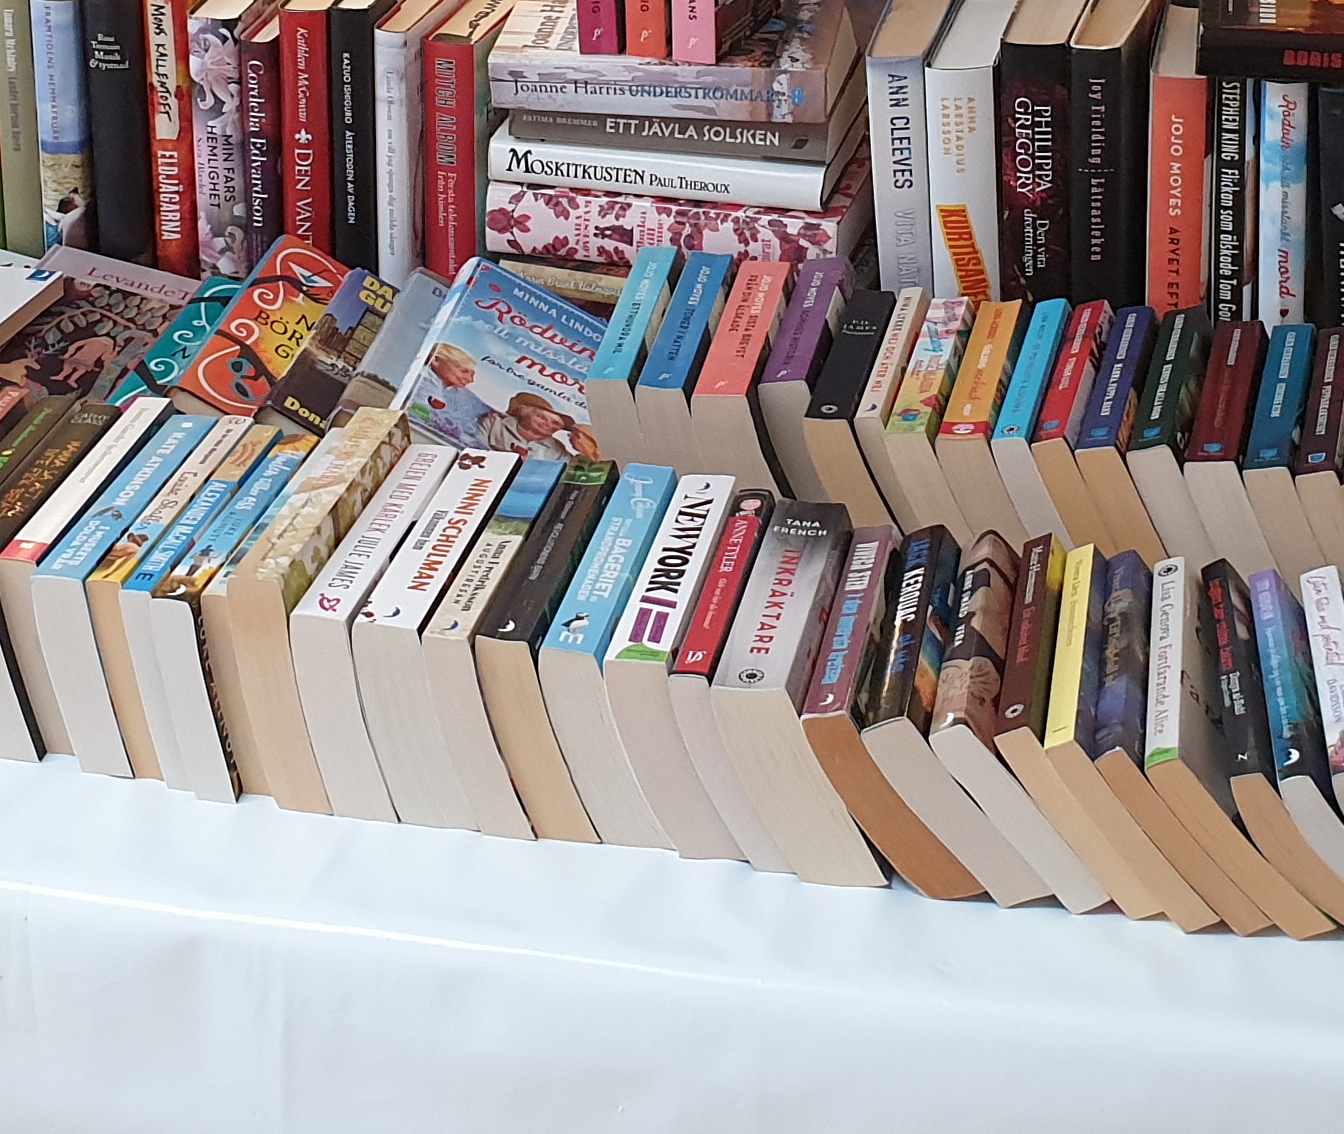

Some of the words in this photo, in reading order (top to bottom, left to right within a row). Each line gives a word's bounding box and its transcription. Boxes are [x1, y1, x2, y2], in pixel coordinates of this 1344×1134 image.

[44, 5, 55, 70] FRAMTIDENS
[296, 26, 309, 71] Kathleen
[154, 43, 173, 123] KALLENTOFT
[342, 53, 351, 83] KAZUO
[435, 58, 456, 108] MITCH
[514, 79, 567, 95] Joanne
[574, 80, 626, 96] Harris
[247, 60, 266, 132] Cordelia
[343, 84, 353, 124] ISHIGURO
[887, 73, 909, 109] ANN
[1221, 81, 1240, 129] STEPHEN
[221, 134, 235, 162] MIN
[435, 113, 457, 166] ALBOM
[605, 118, 638, 135] ETT
[641, 119, 698, 140] JÄVLA
[703, 125, 780, 147] SOLSKEN
[889, 115, 914, 190] CLEEVES
[1014, 96, 1033, 200] GREGORY
[1033, 105, 1053, 194] PHILIPPA
[1088, 102, 1107, 165] Fielding
[1171, 114, 1184, 156] JOJO
[1220, 132, 1239, 162] KING
[206, 125, 221, 210] HEMLIGHET
[294, 149, 313, 191] DEN
[345, 131, 356, 183] ÅTERSTODEN
[506, 147, 646, 186] MOSKITKUSTEN
[648, 173, 676, 190] PAUL
[677, 176, 731, 195] THEROUX
[157, 150, 182, 241] ELDJÄGARNA
[223, 167, 236, 203] FARS
[250, 138, 269, 227] Edvardson
[1169, 161, 1183, 217] MOYES
[1220, 168, 1240, 203] Flickan
[347, 196, 356, 224] DAGEN
[1037, 219, 1050, 240] Den
[1220, 205, 1235, 230] som
[1023, 208, 1036, 277] drottningen
[1037, 242, 1049, 269] vita
[1168, 226, 1182, 270] ARVET
[513, 287, 557, 318] MINNA
[1219, 278, 1238, 299] Tom
[454, 478, 493, 516] NINNI
[773, 526, 827, 536] FRENCH
[786, 519, 821, 528] TANA
[407, 517, 468, 592] SCHULMAN
[749, 549, 804, 655] INKRÄKTARE
